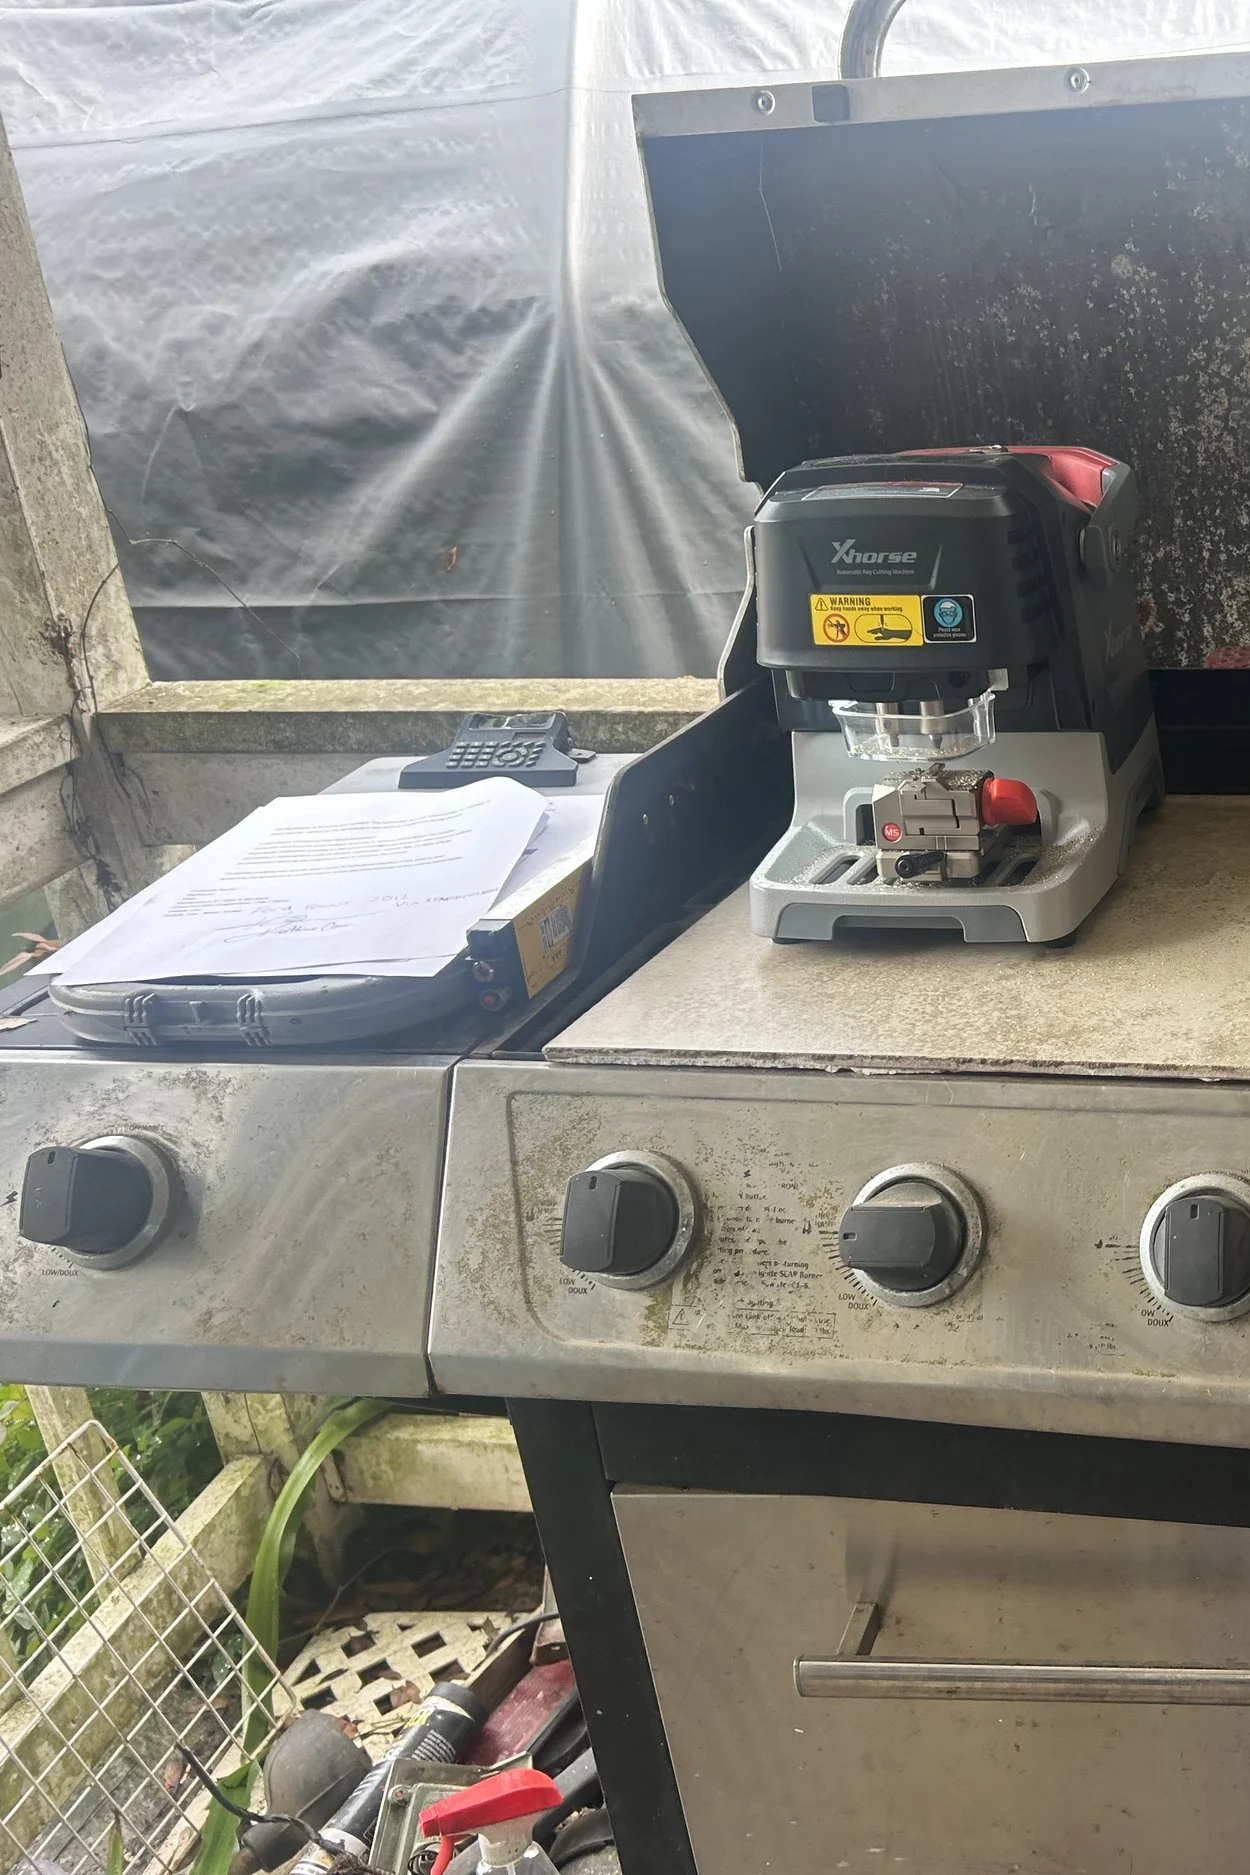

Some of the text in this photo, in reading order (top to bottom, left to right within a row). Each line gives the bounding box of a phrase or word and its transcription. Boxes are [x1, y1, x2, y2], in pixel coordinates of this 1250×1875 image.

[831, 539, 917, 564] Xhorse
[830, 597, 871, 606] WARNING
[847, 1302, 869, 1310] DOUX
[1141, 1309, 1156, 1317] OW
[1147, 1319, 1169, 1327] DOUX
